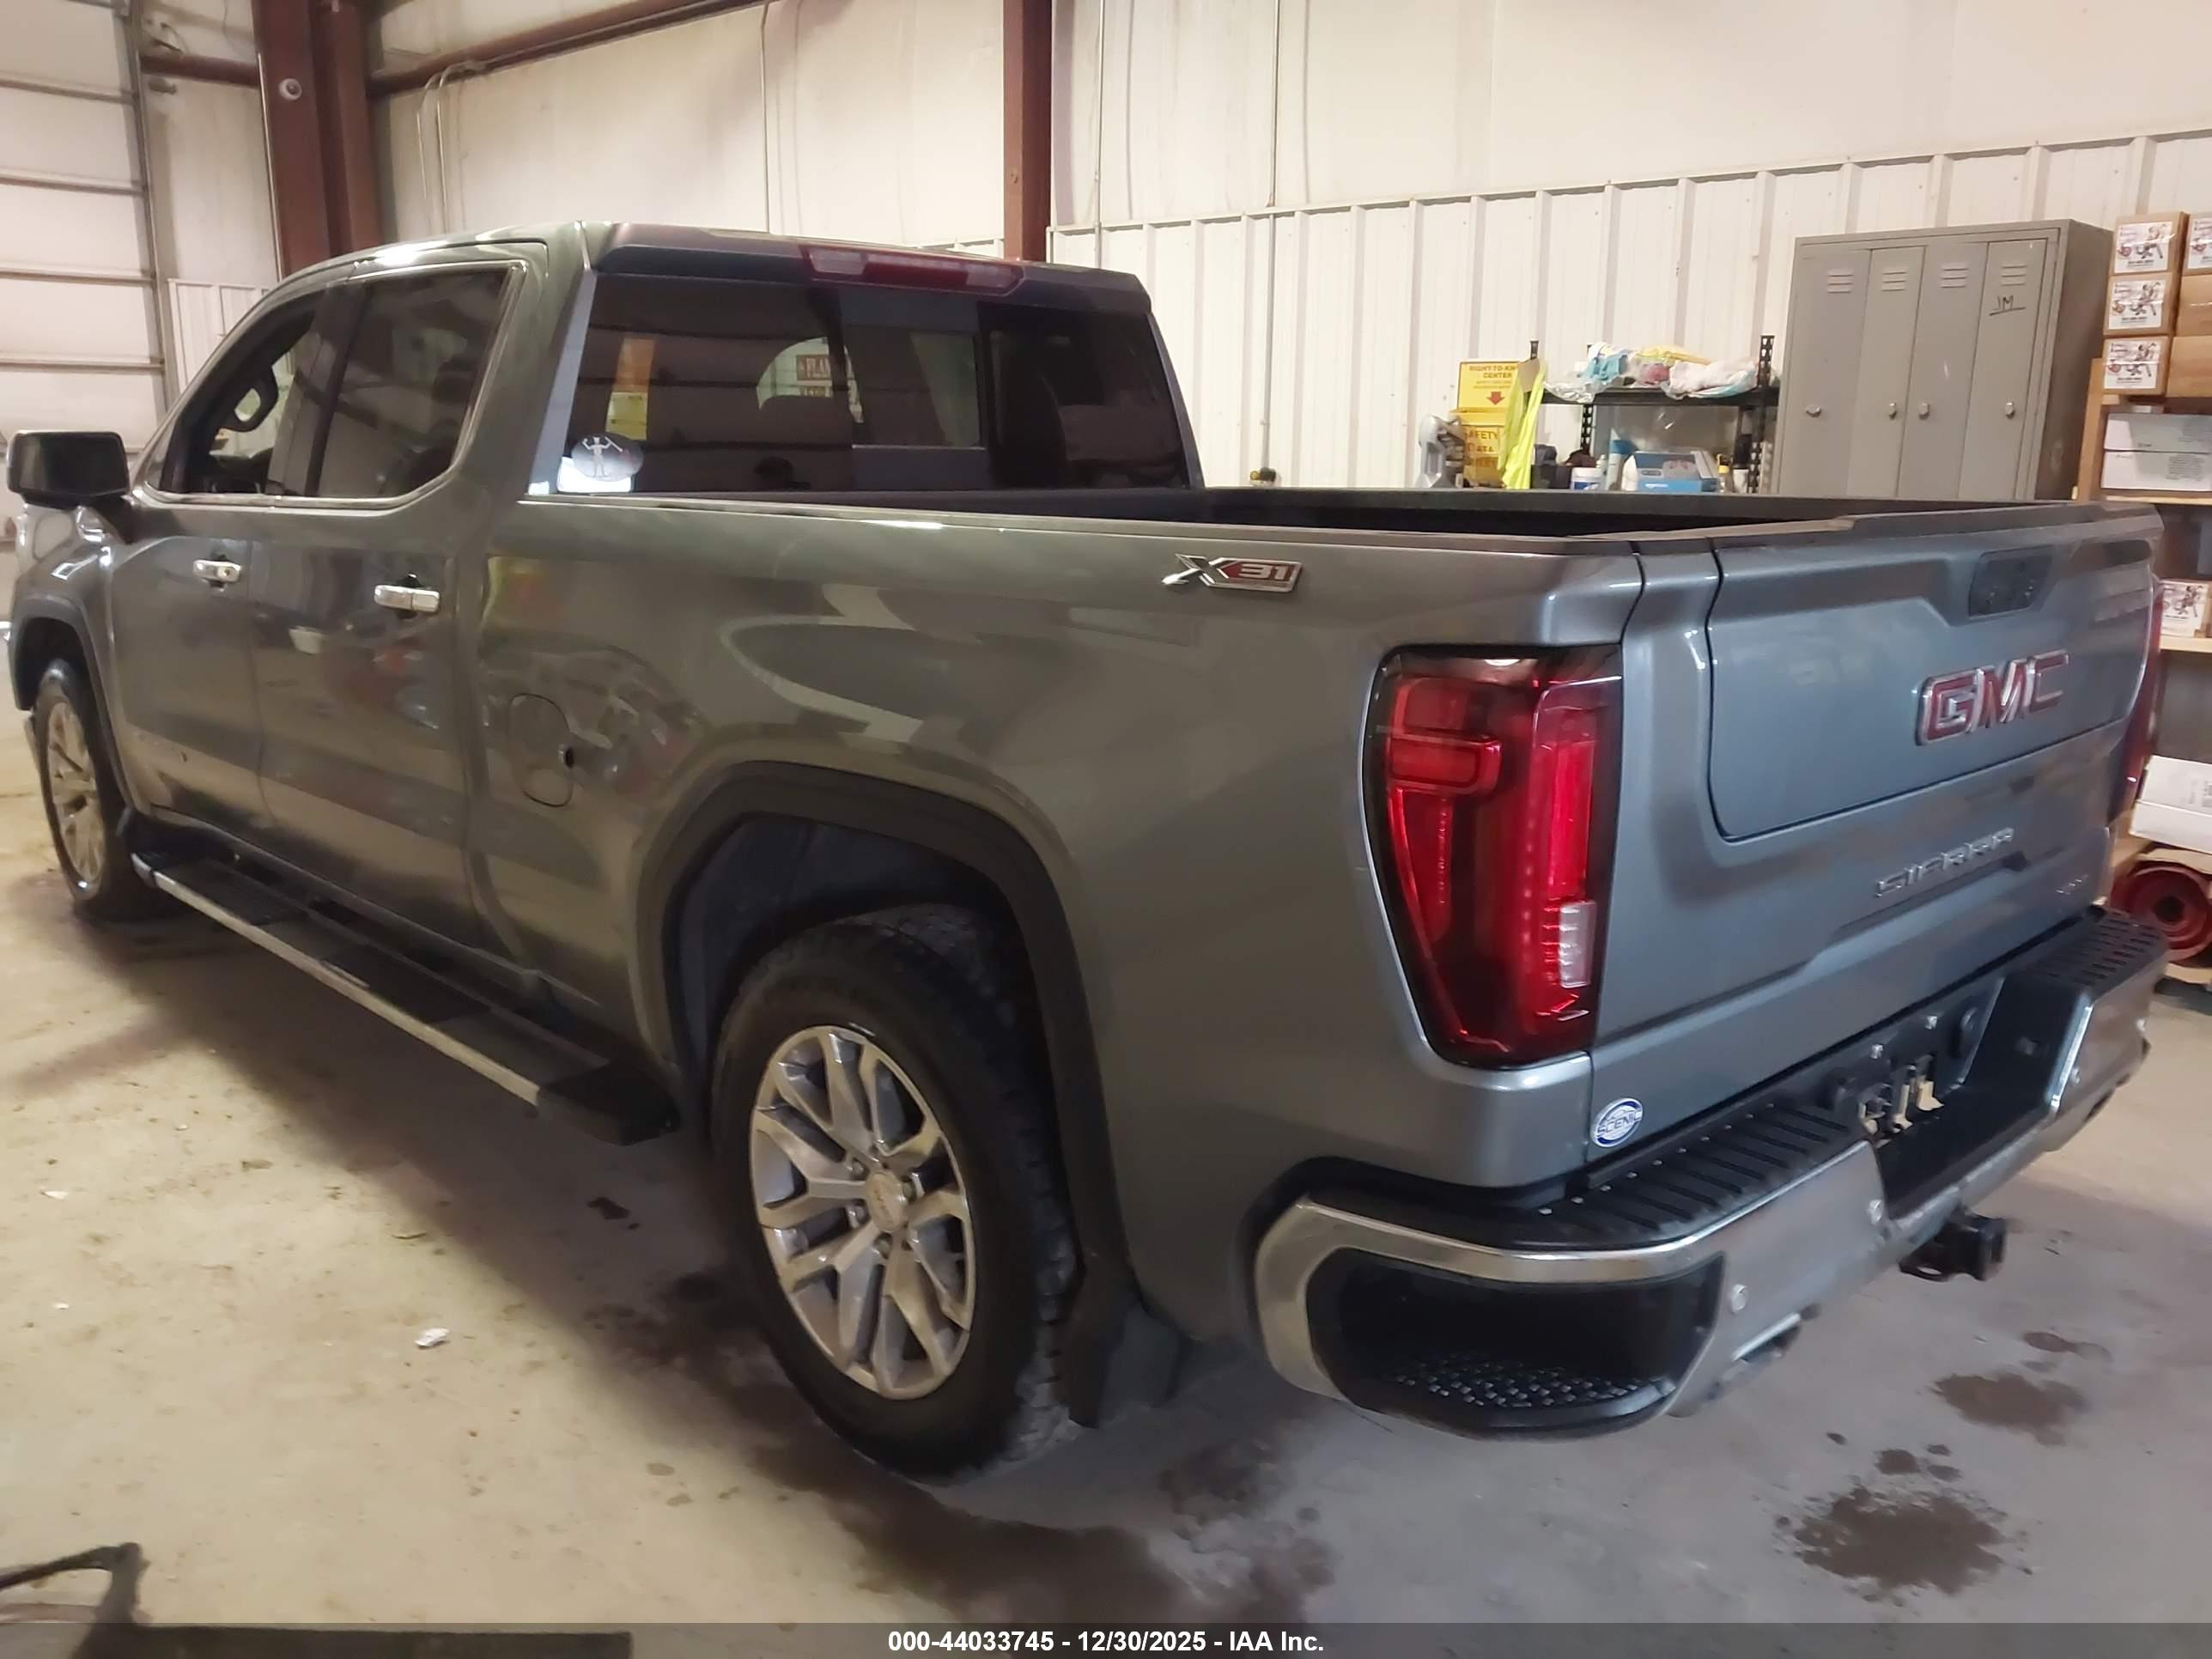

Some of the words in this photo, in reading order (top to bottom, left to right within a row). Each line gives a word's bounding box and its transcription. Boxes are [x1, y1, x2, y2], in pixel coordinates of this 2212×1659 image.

[1161, 553, 1298, 590] X31
[1914, 647, 2070, 745] GMC
[1874, 827, 2015, 898] SIERRA
